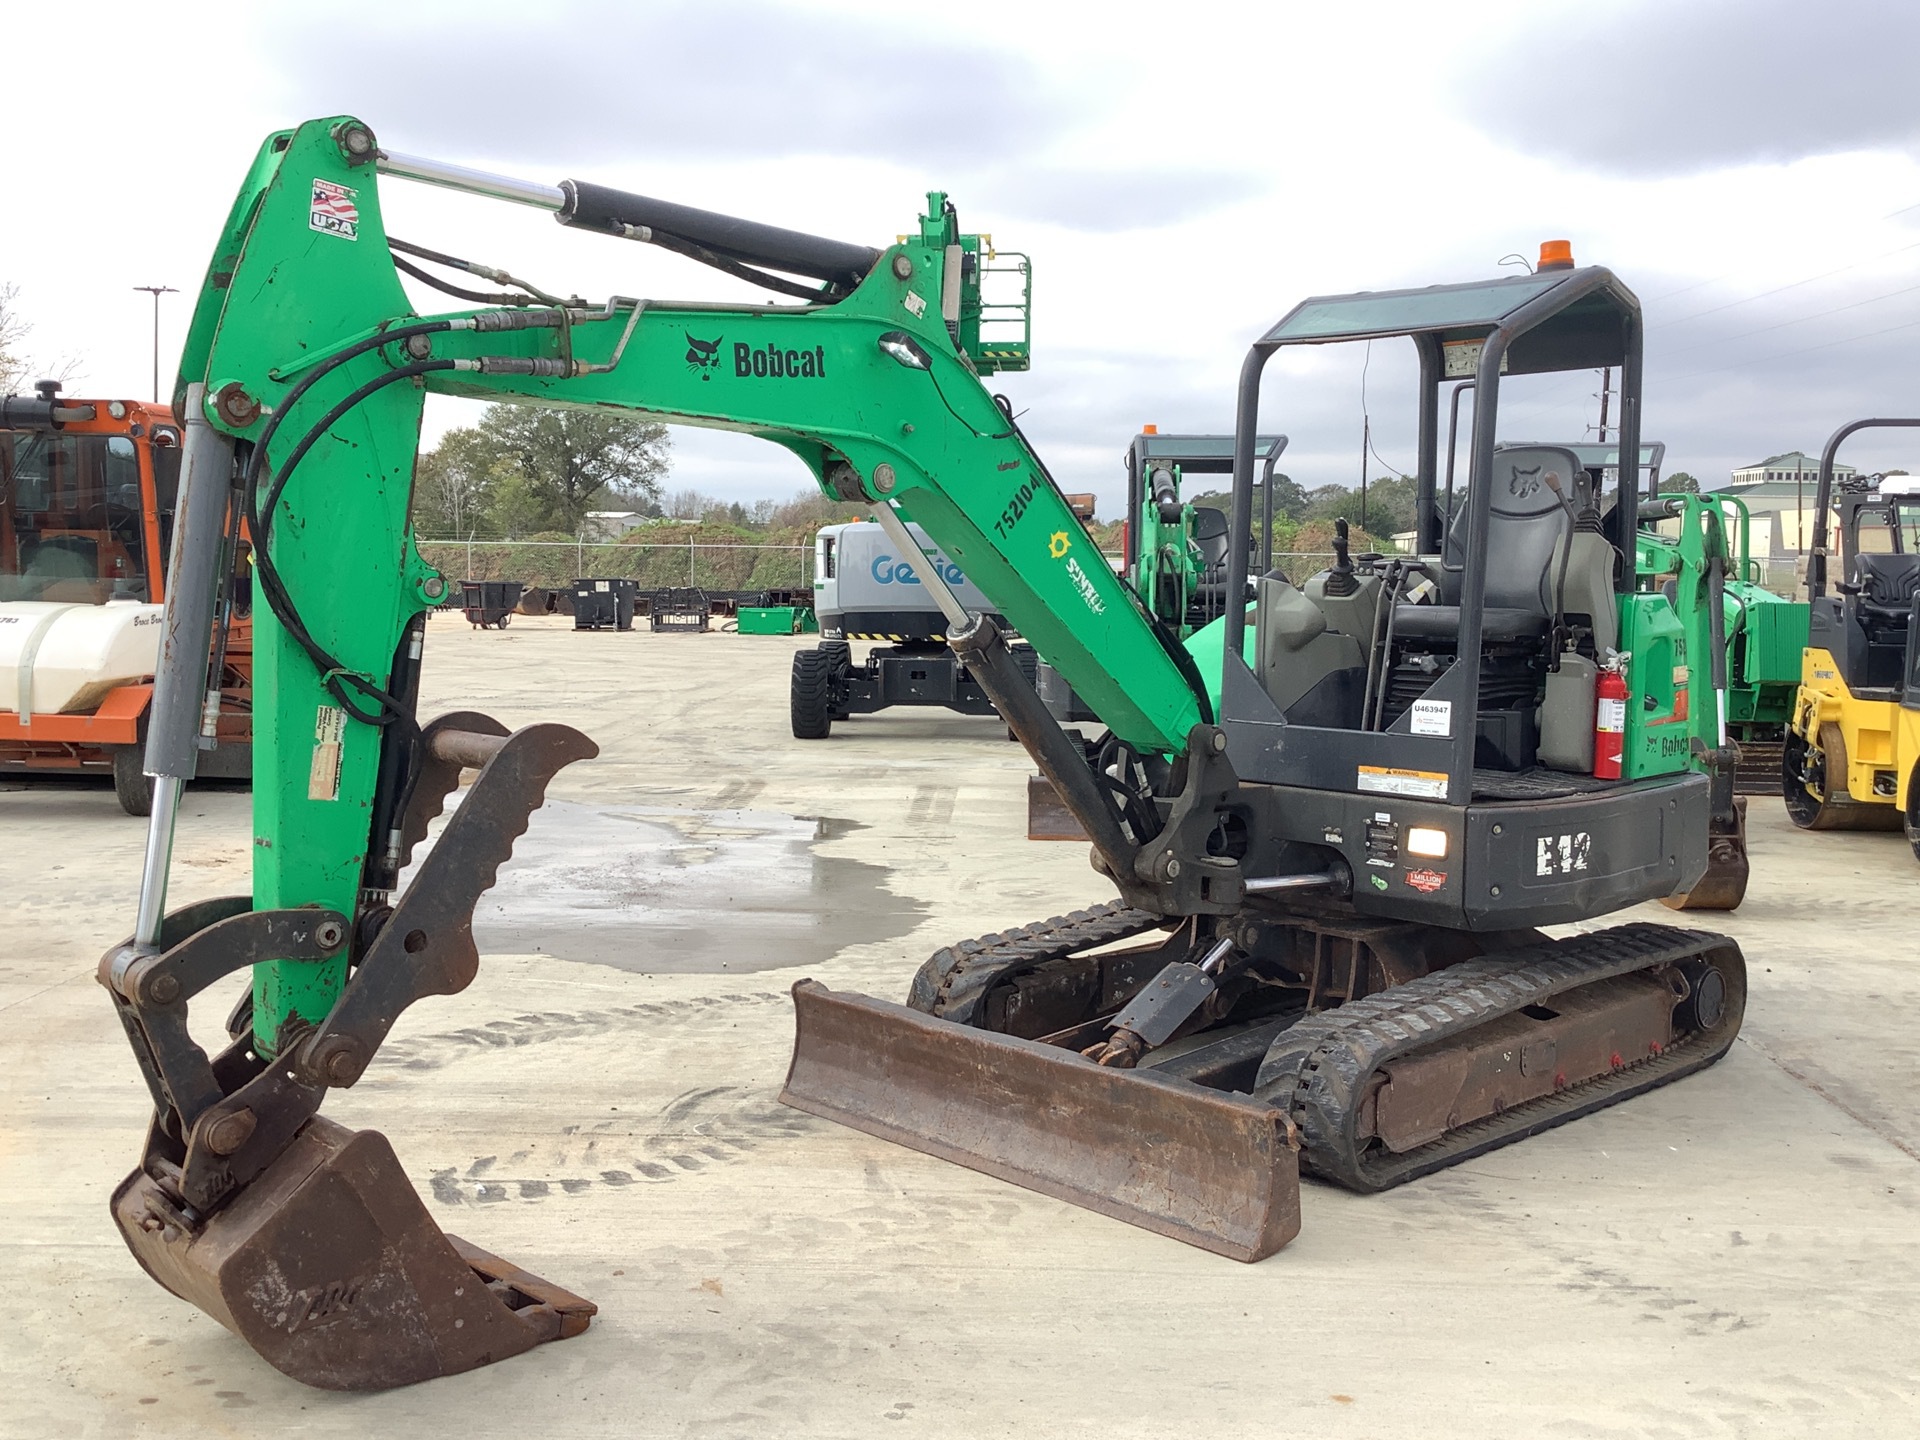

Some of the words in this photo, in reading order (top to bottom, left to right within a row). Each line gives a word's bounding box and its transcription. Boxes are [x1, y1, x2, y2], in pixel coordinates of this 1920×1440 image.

[312, 213, 355, 235] USA
[733, 342, 826, 378] Bobcat
[871, 555, 964, 585] Geie
[1414, 704, 1449, 713] U463947
[1661, 735, 1689, 758] Bobca
[1414, 873, 1441, 883] MILLION
